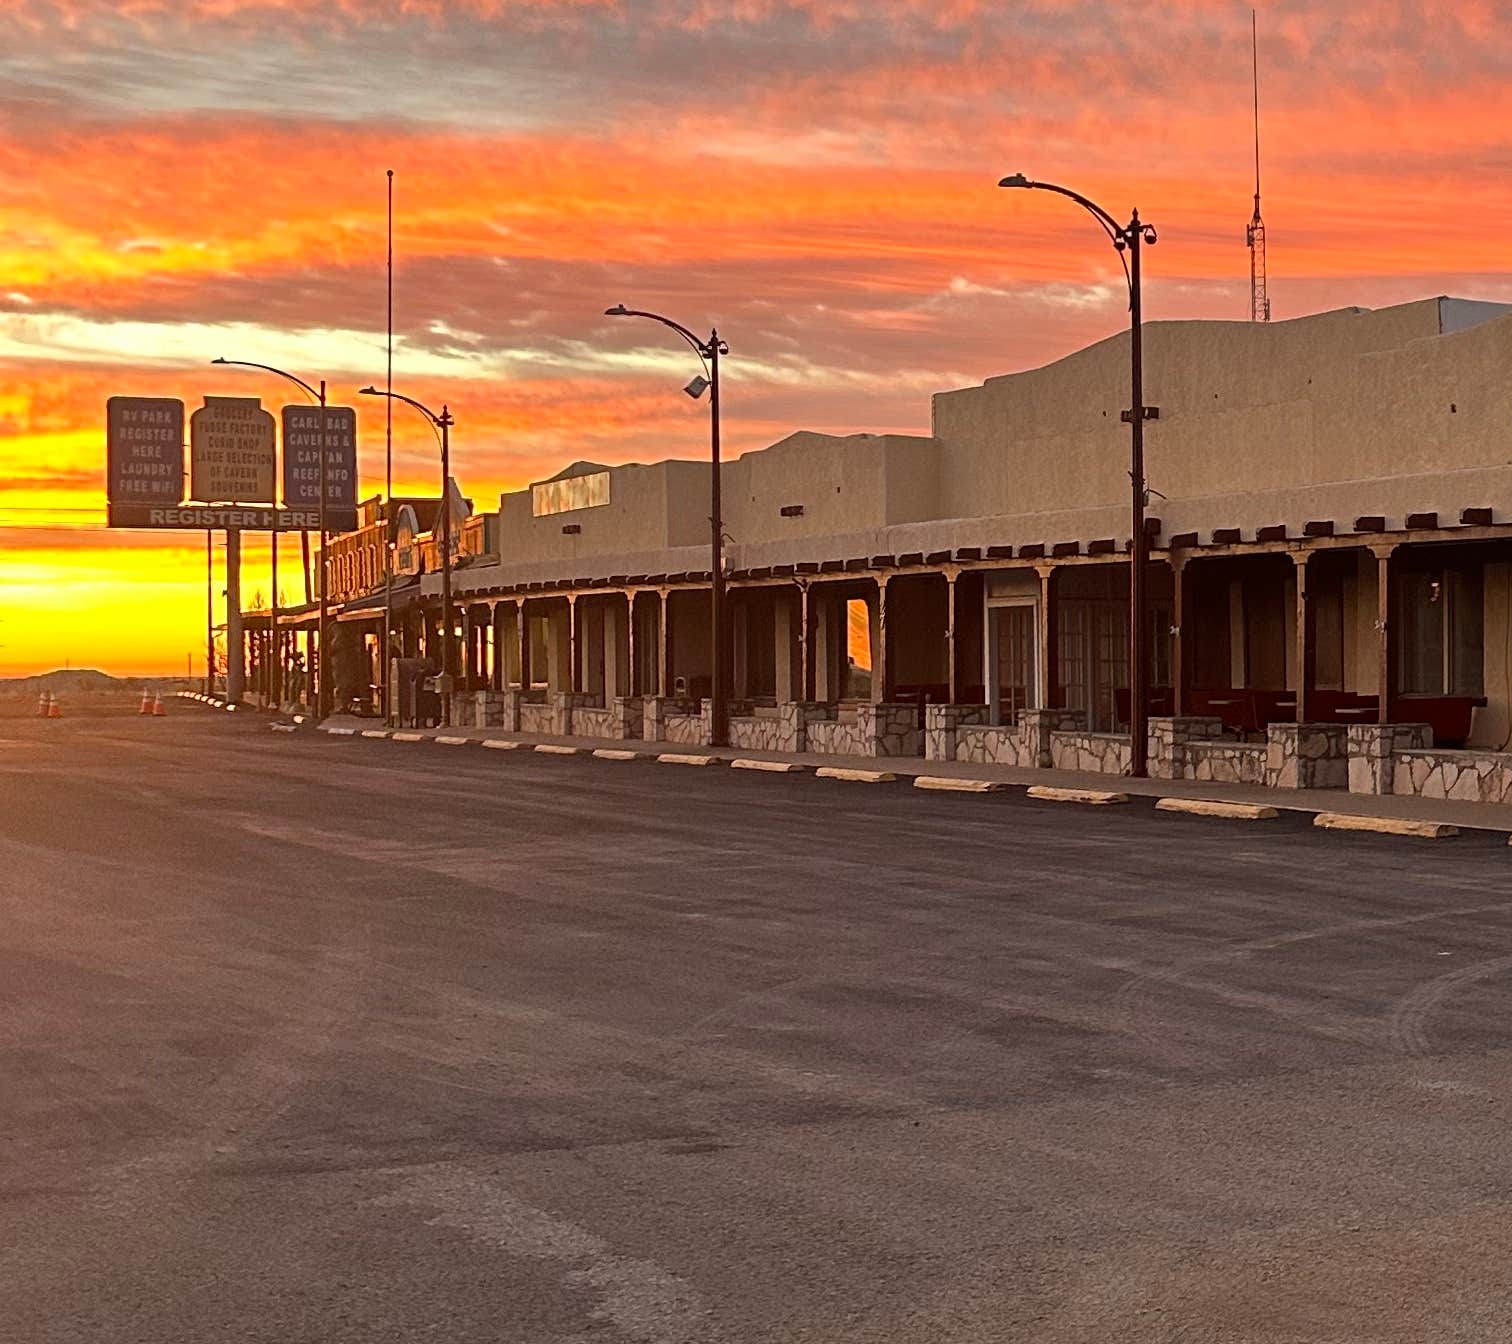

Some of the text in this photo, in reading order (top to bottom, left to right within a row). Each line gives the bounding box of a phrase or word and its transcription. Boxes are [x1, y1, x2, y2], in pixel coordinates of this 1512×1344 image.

[142, 410, 172, 424] PARK
[291, 416, 348, 430] CARLBAD
[119, 427, 175, 441] REGISTER
[230, 422, 267, 435] FACTORY
[238, 438, 260, 450] SHOP
[132, 445, 161, 458] HERE
[227, 452, 272, 464] SELECTION
[297, 451, 343, 464] CAPIAN
[120, 462, 173, 476] LAUNDRY
[210, 466, 222, 478] OF
[293, 468, 348, 481] REEF NFO
[119, 479, 149, 493] FREE
[300, 485, 342, 497] CENER
[150, 509, 257, 526] REGISTER
